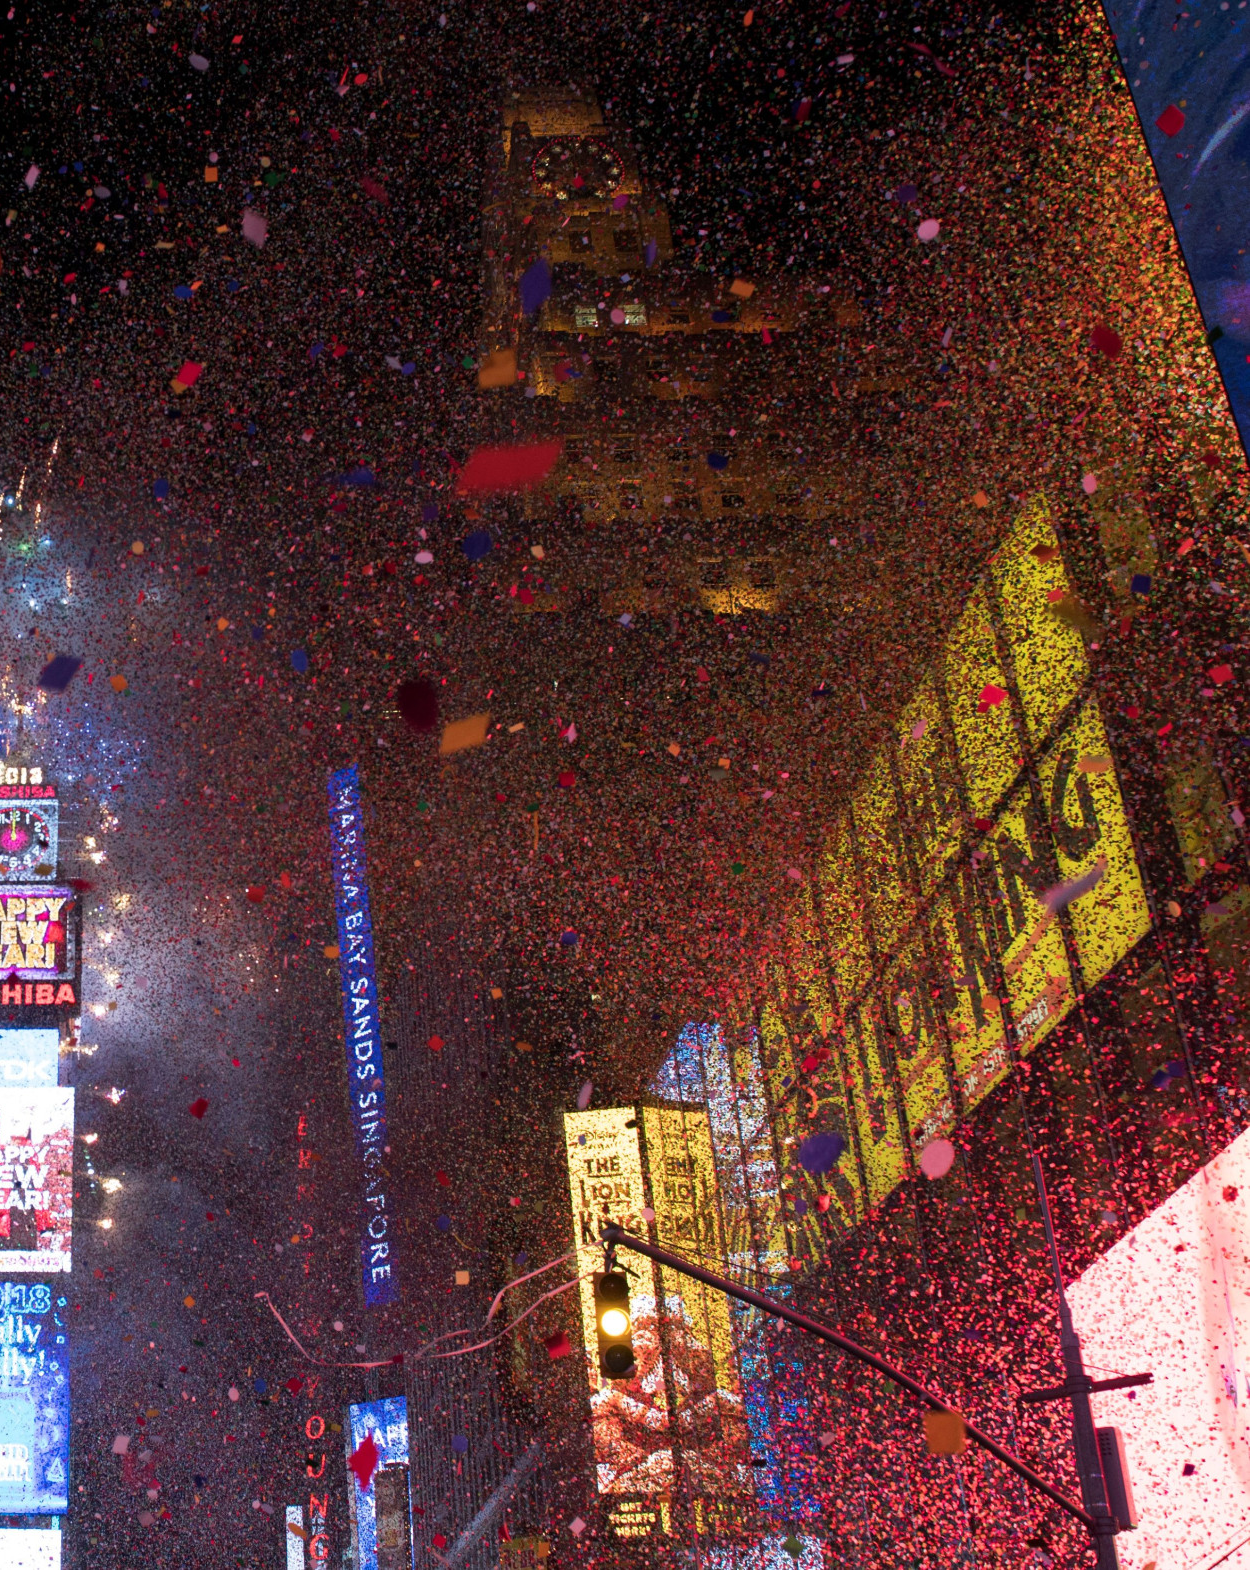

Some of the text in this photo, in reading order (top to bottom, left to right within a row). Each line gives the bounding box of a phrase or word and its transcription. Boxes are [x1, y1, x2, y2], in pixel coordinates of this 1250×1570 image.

[350, 977, 375, 1081] SANDS
[583, 1155, 620, 1174] THE
[305, 1376, 330, 1560] YOUNG
